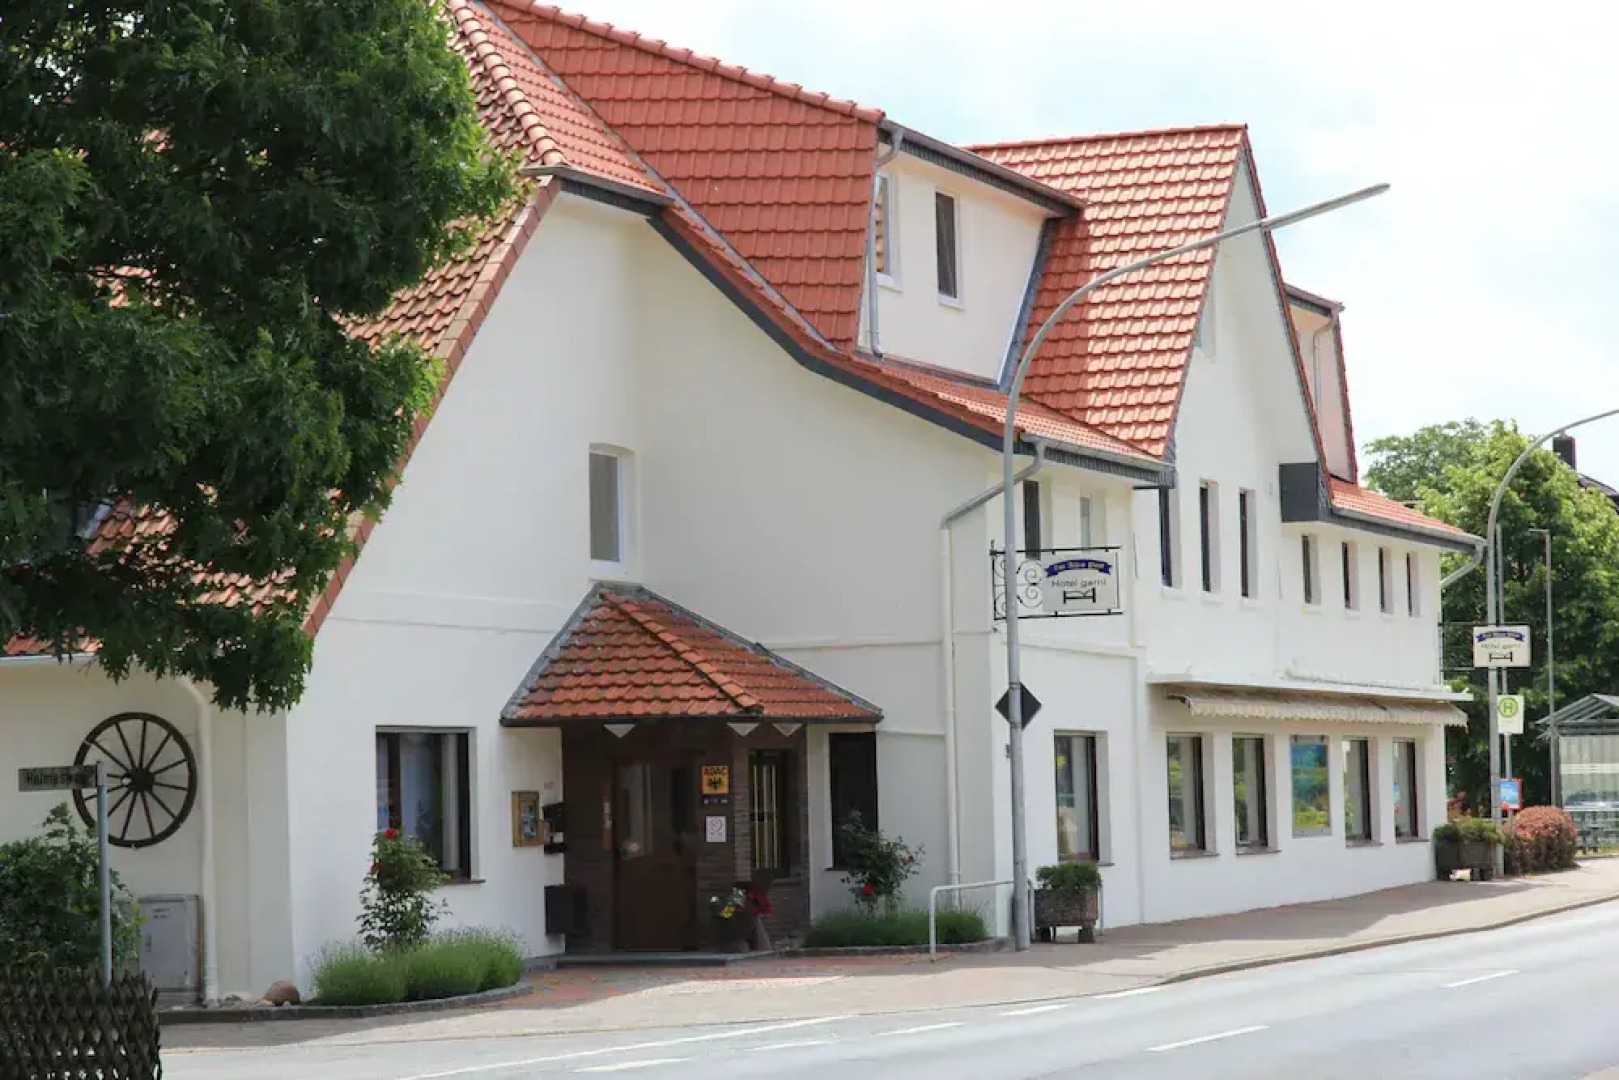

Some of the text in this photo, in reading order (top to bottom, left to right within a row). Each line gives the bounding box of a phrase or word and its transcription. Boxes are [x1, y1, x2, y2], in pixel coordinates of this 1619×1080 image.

[1051, 578, 1107, 587] Hotel garni
[704, 766, 728, 776] ADAC
